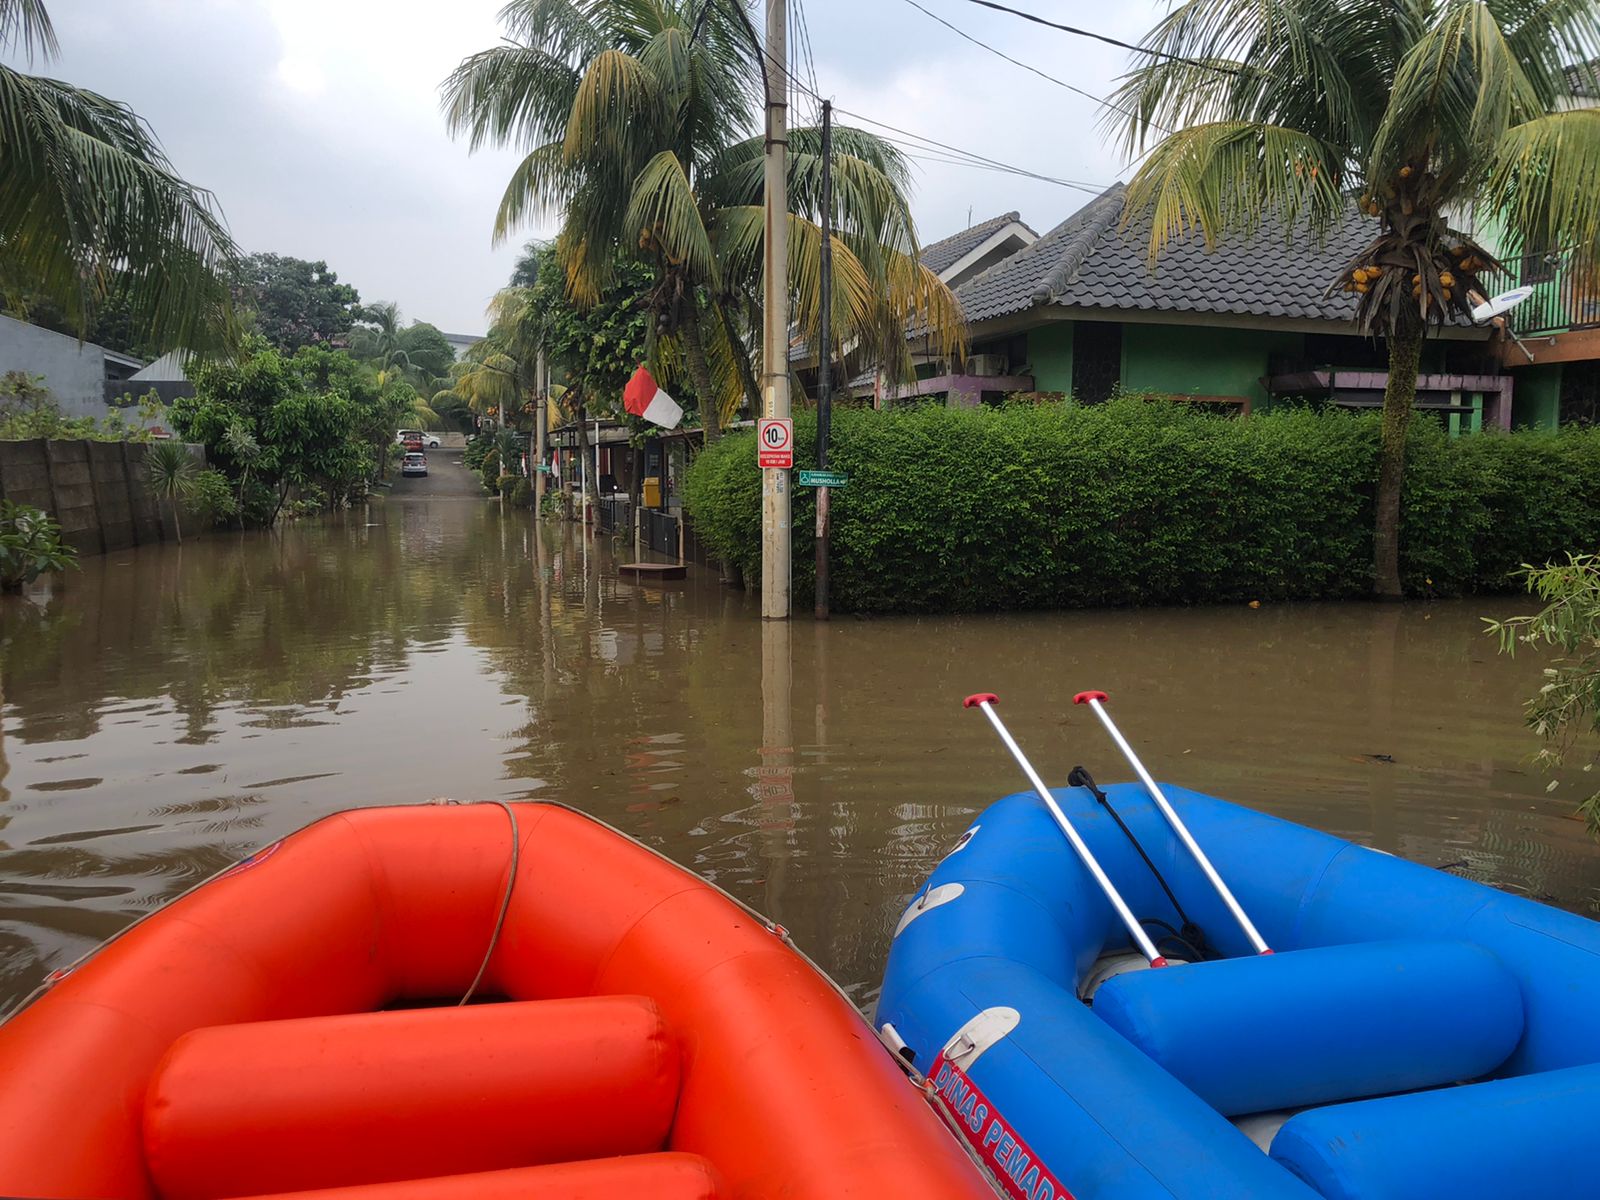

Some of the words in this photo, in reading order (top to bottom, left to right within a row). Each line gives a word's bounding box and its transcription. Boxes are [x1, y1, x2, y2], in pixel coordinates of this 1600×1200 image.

[766, 428, 778, 443] 10
[934, 1061, 989, 1134] DINAS
[983, 1119, 1067, 1200] PEMAD
